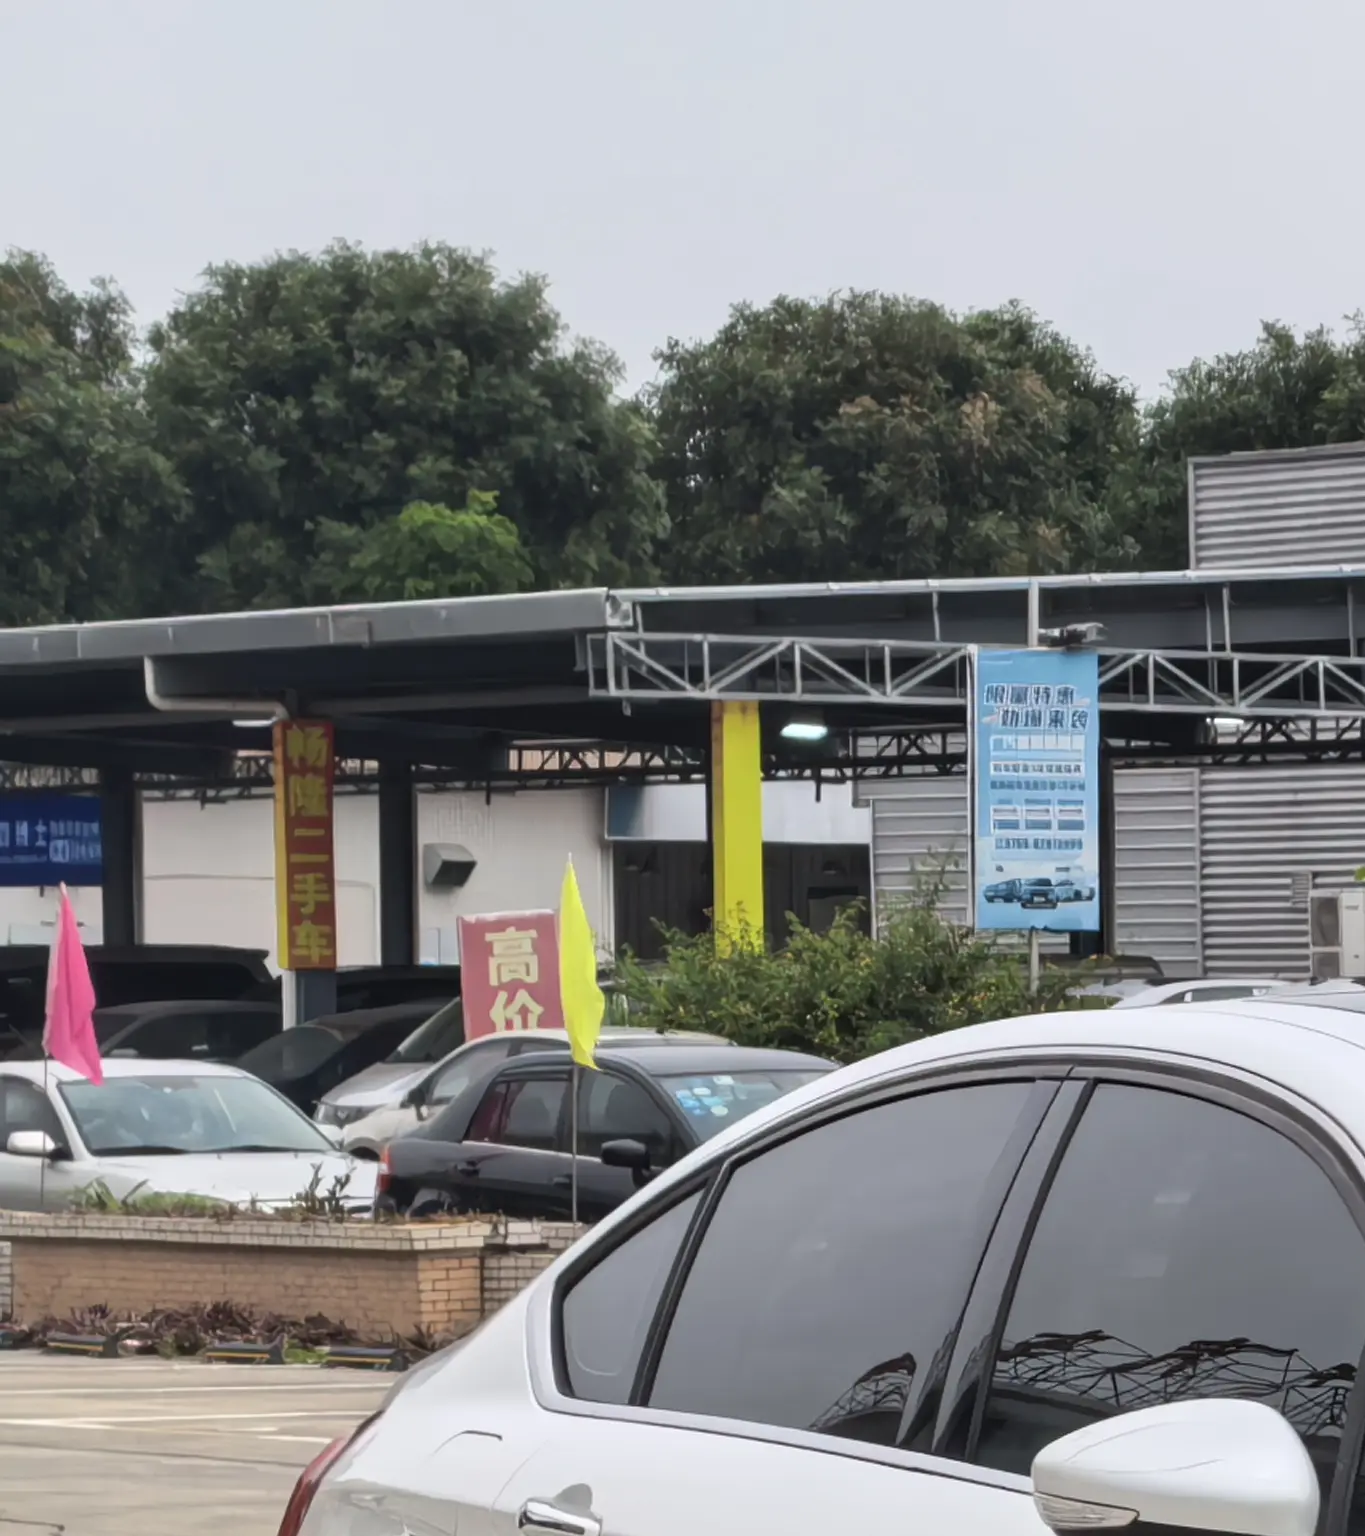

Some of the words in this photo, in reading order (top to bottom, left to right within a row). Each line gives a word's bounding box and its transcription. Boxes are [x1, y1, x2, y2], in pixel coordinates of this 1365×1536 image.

[286, 724, 333, 965] 畅隆二手车
[484, 926, 545, 1033] 高价
